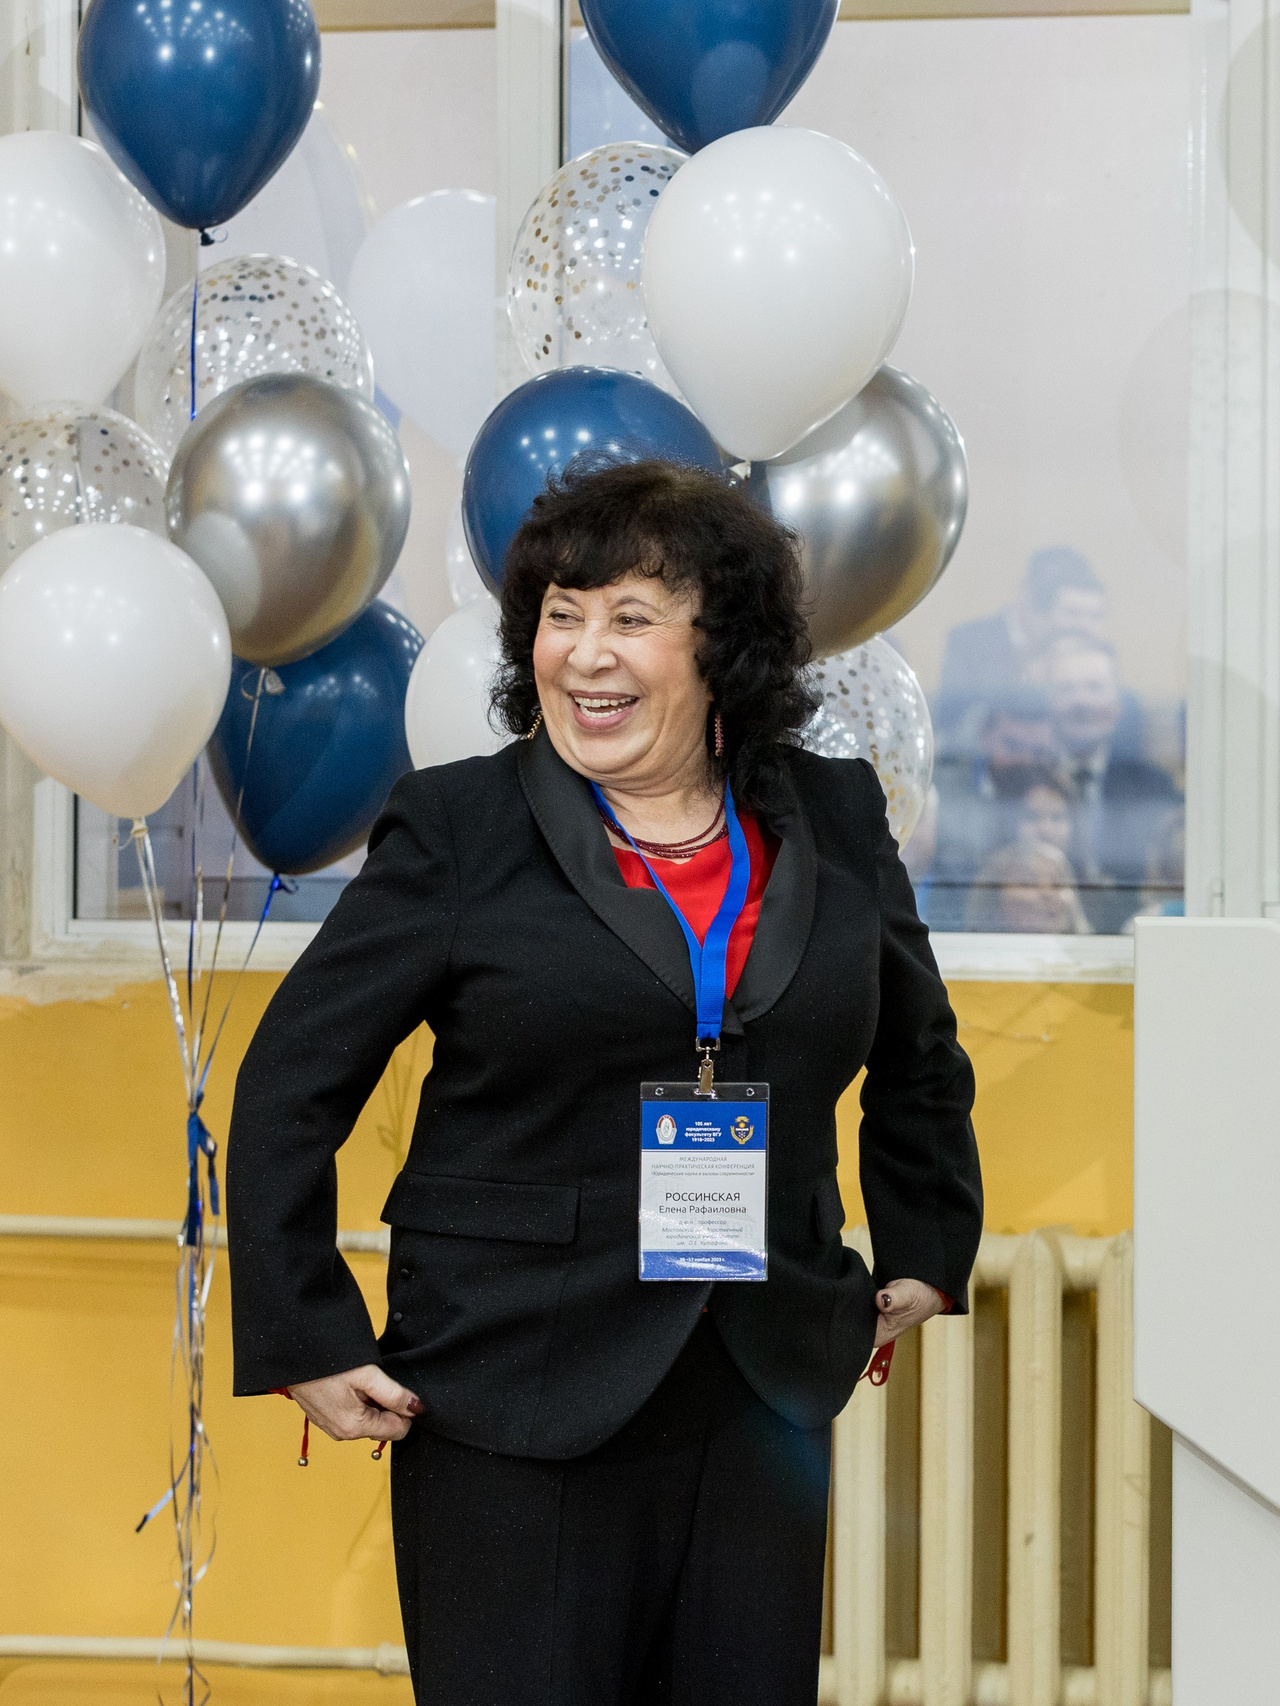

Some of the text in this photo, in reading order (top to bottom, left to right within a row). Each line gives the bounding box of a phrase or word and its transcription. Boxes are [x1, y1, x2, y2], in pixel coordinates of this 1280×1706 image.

[665, 1192, 741, 1202] РОССИНСКАЯ
[659, 1205, 747, 1215] Елена Рафаиловна
